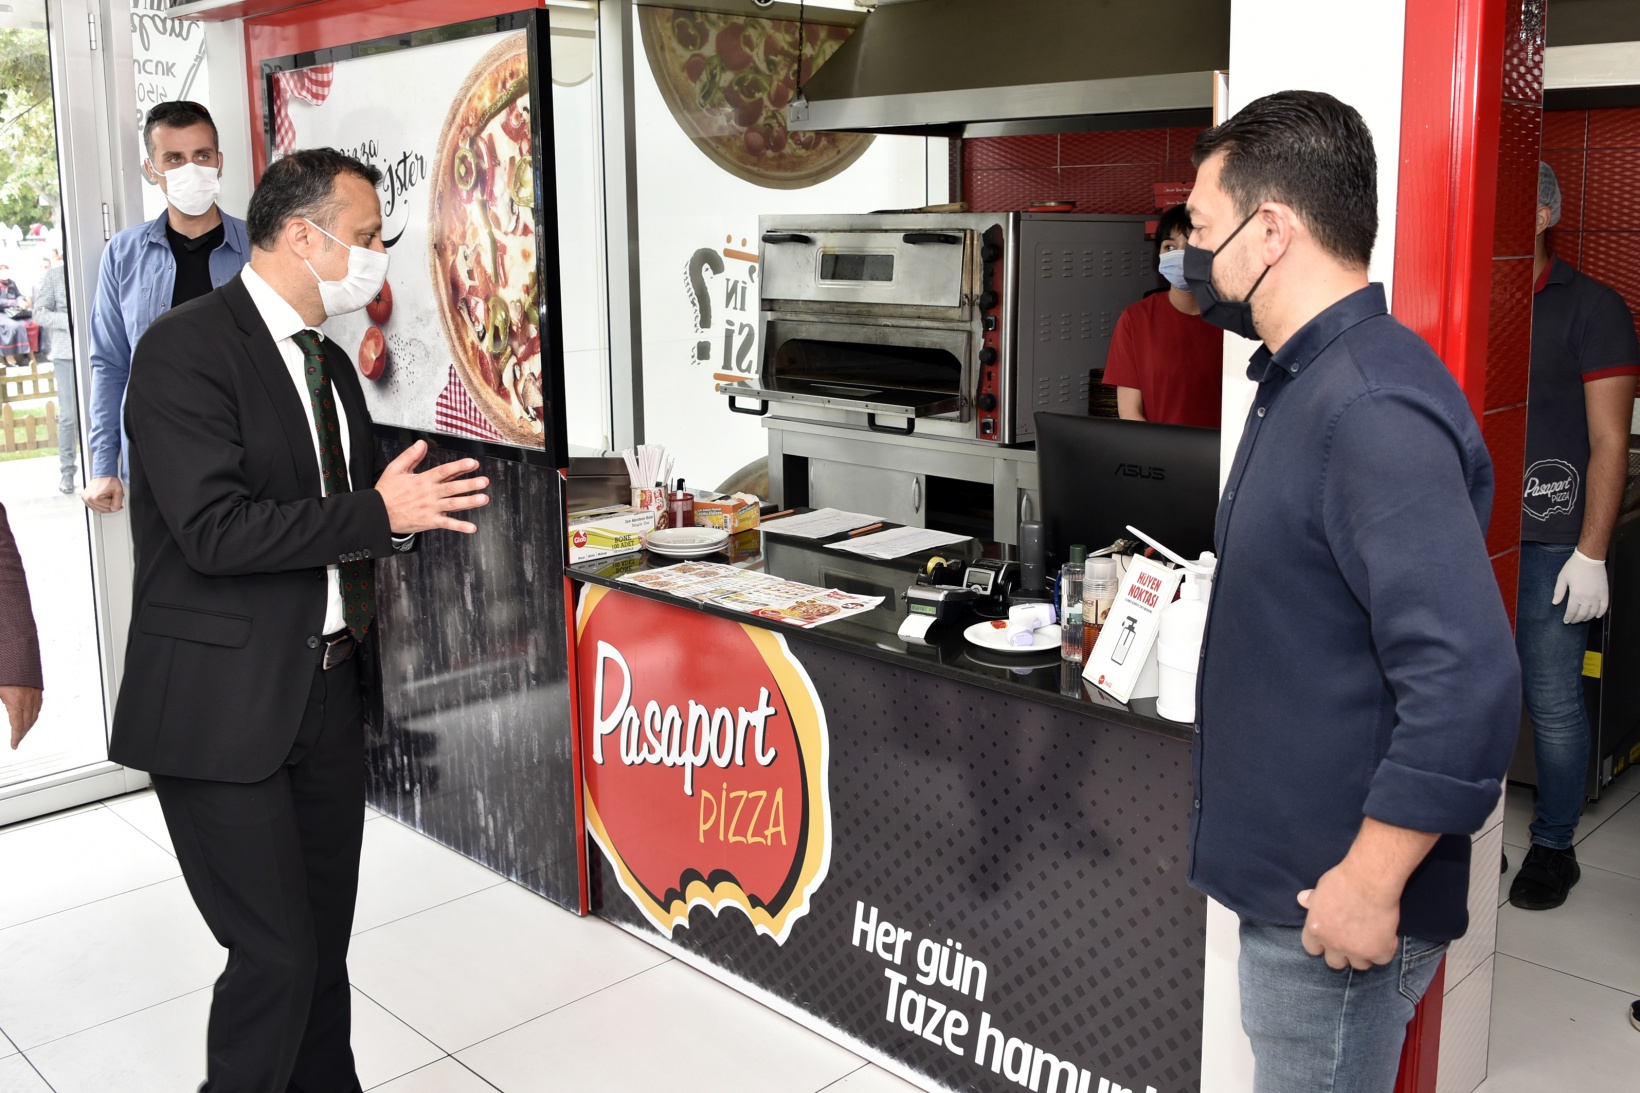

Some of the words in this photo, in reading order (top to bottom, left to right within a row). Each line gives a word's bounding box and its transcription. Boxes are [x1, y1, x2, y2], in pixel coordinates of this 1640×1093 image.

[1114, 463, 1166, 481] ASUS
[1524, 476, 1572, 498] Pasaport
[614, 534, 632, 544] BONE
[620, 540, 635, 549] ADET
[1127, 583, 1159, 608] NOKTASI
[592, 640, 778, 796] Pasaport
[852, 900, 912, 965] Her
[916, 937, 988, 1002] gün
[884, 967, 970, 1056] Taze
